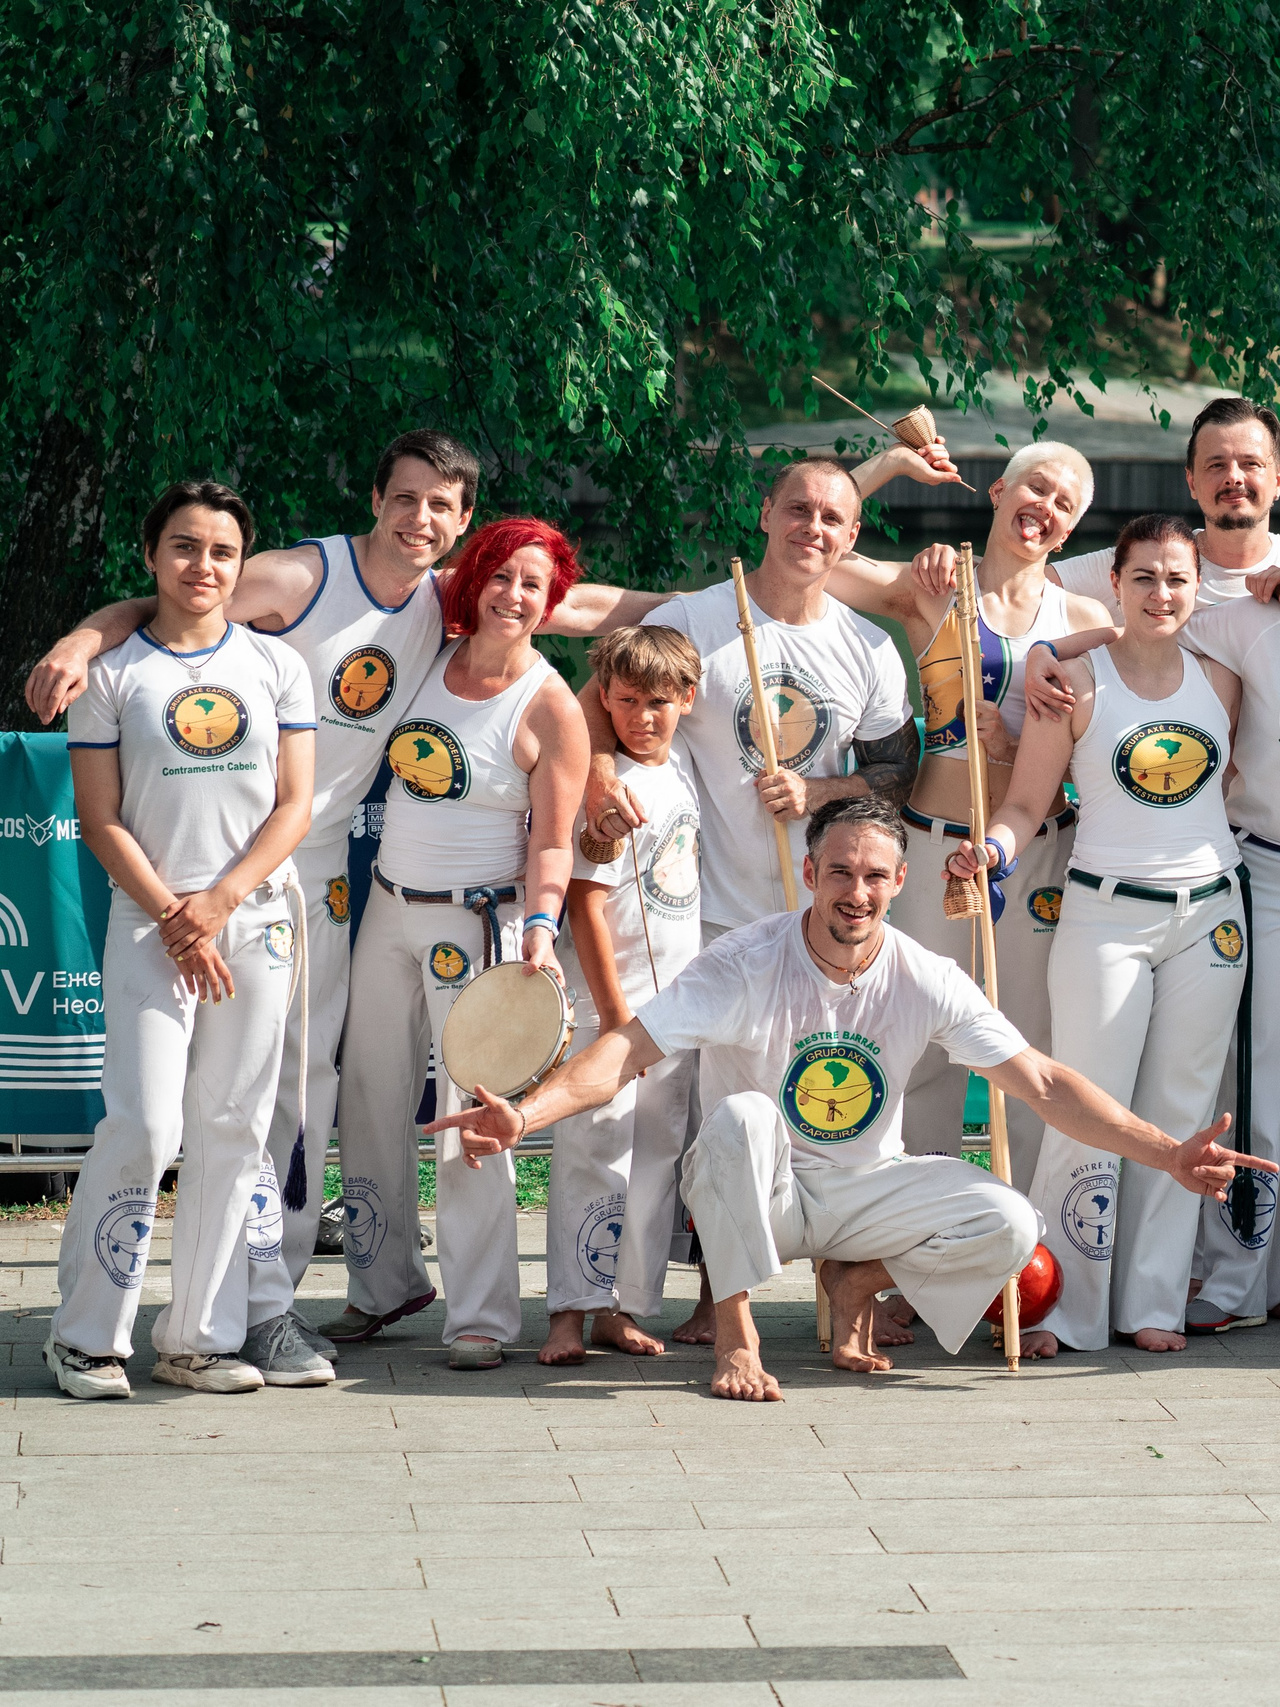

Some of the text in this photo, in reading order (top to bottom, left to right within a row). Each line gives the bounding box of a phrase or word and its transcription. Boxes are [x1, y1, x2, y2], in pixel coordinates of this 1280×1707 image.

[341, 651, 362, 669] GRUPO
[169, 693, 187, 712] GRUPO
[206, 687, 241, 707] CAPOEIRA
[320, 715, 355, 728] Professor
[178, 739, 208, 756] MESTRE
[390, 723, 463, 771] GRUPO AXÉ CAPOEIRA
[1121, 723, 1214, 756] GRUPO AXÉ CAPOEIRA
[162, 761, 258, 776] Contramestre Cabelo
[1131, 784, 1164, 803] MESTRE
[651, 887, 682, 906] MESTRE
[794, 1031, 881, 1056] MESTRE BARRÃO
[805, 1048, 846, 1063] GRUPO
[799, 1122, 859, 1140] CAPOEIRA
[1070, 1162, 1103, 1180] MESTRE
[1080, 1179, 1109, 1191] GRUPO
[108, 1187, 149, 1203] MESTRE
[122, 1206, 153, 1215] GRUPO
